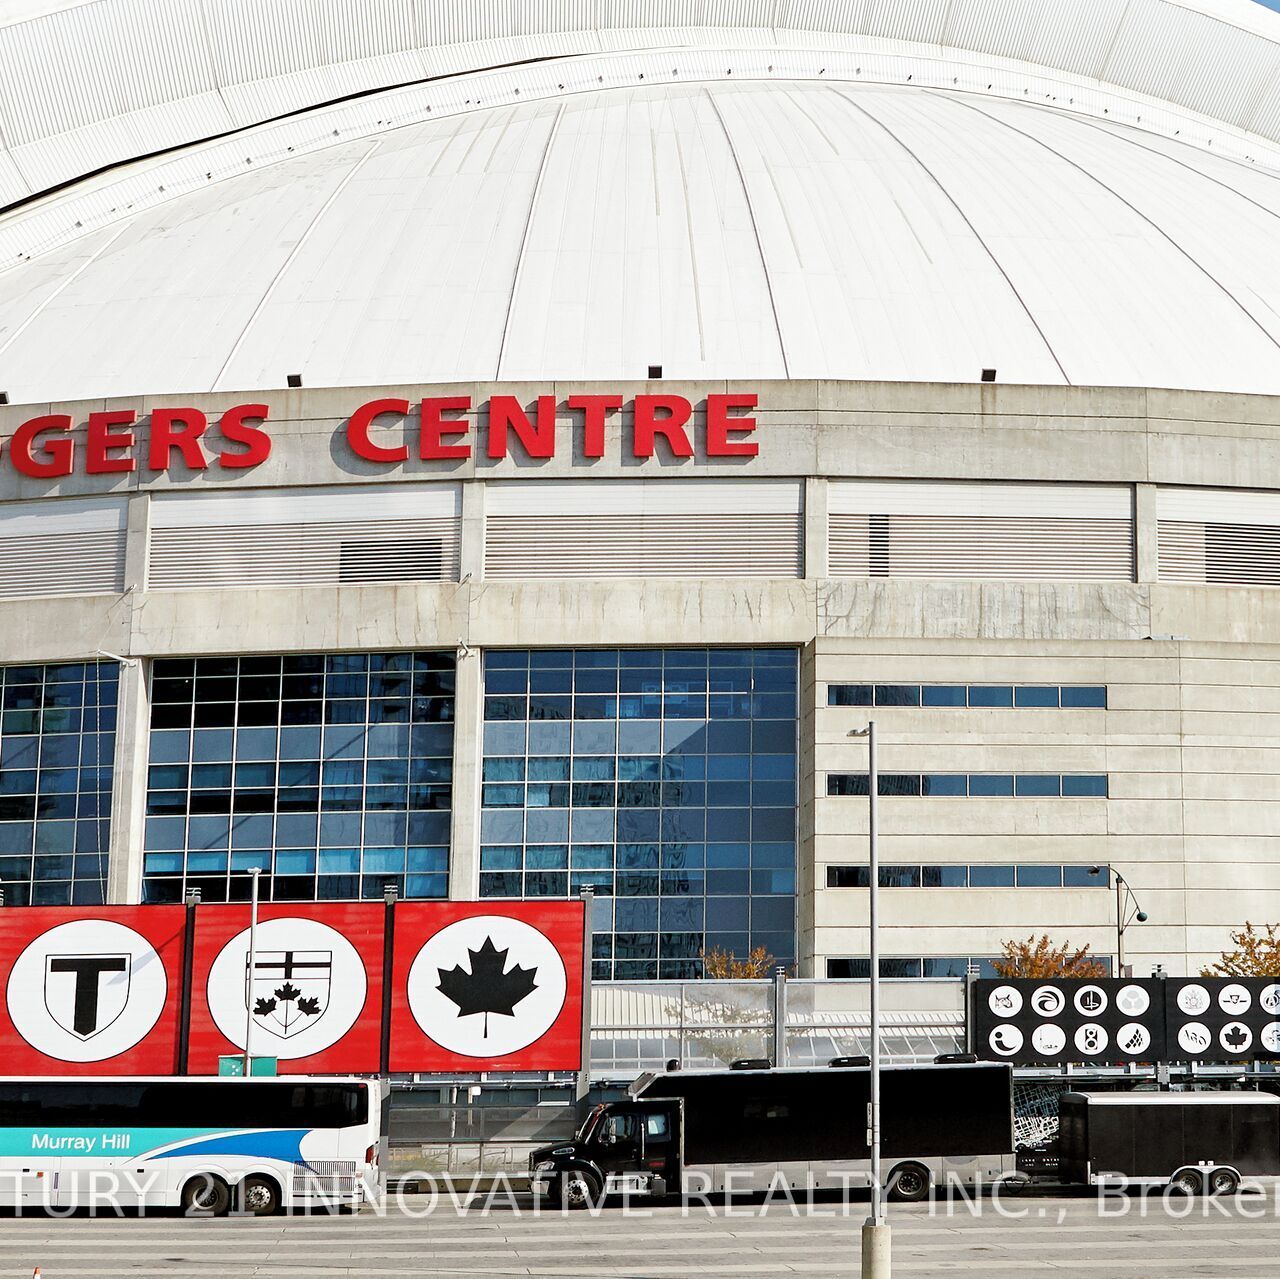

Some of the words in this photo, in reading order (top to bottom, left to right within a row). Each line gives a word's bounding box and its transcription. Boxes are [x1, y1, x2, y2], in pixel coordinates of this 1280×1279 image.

[346, 394, 759, 462] CENTRE
[31, 1133, 96, 1153] Murray
[101, 1133, 131, 1149] Hill
